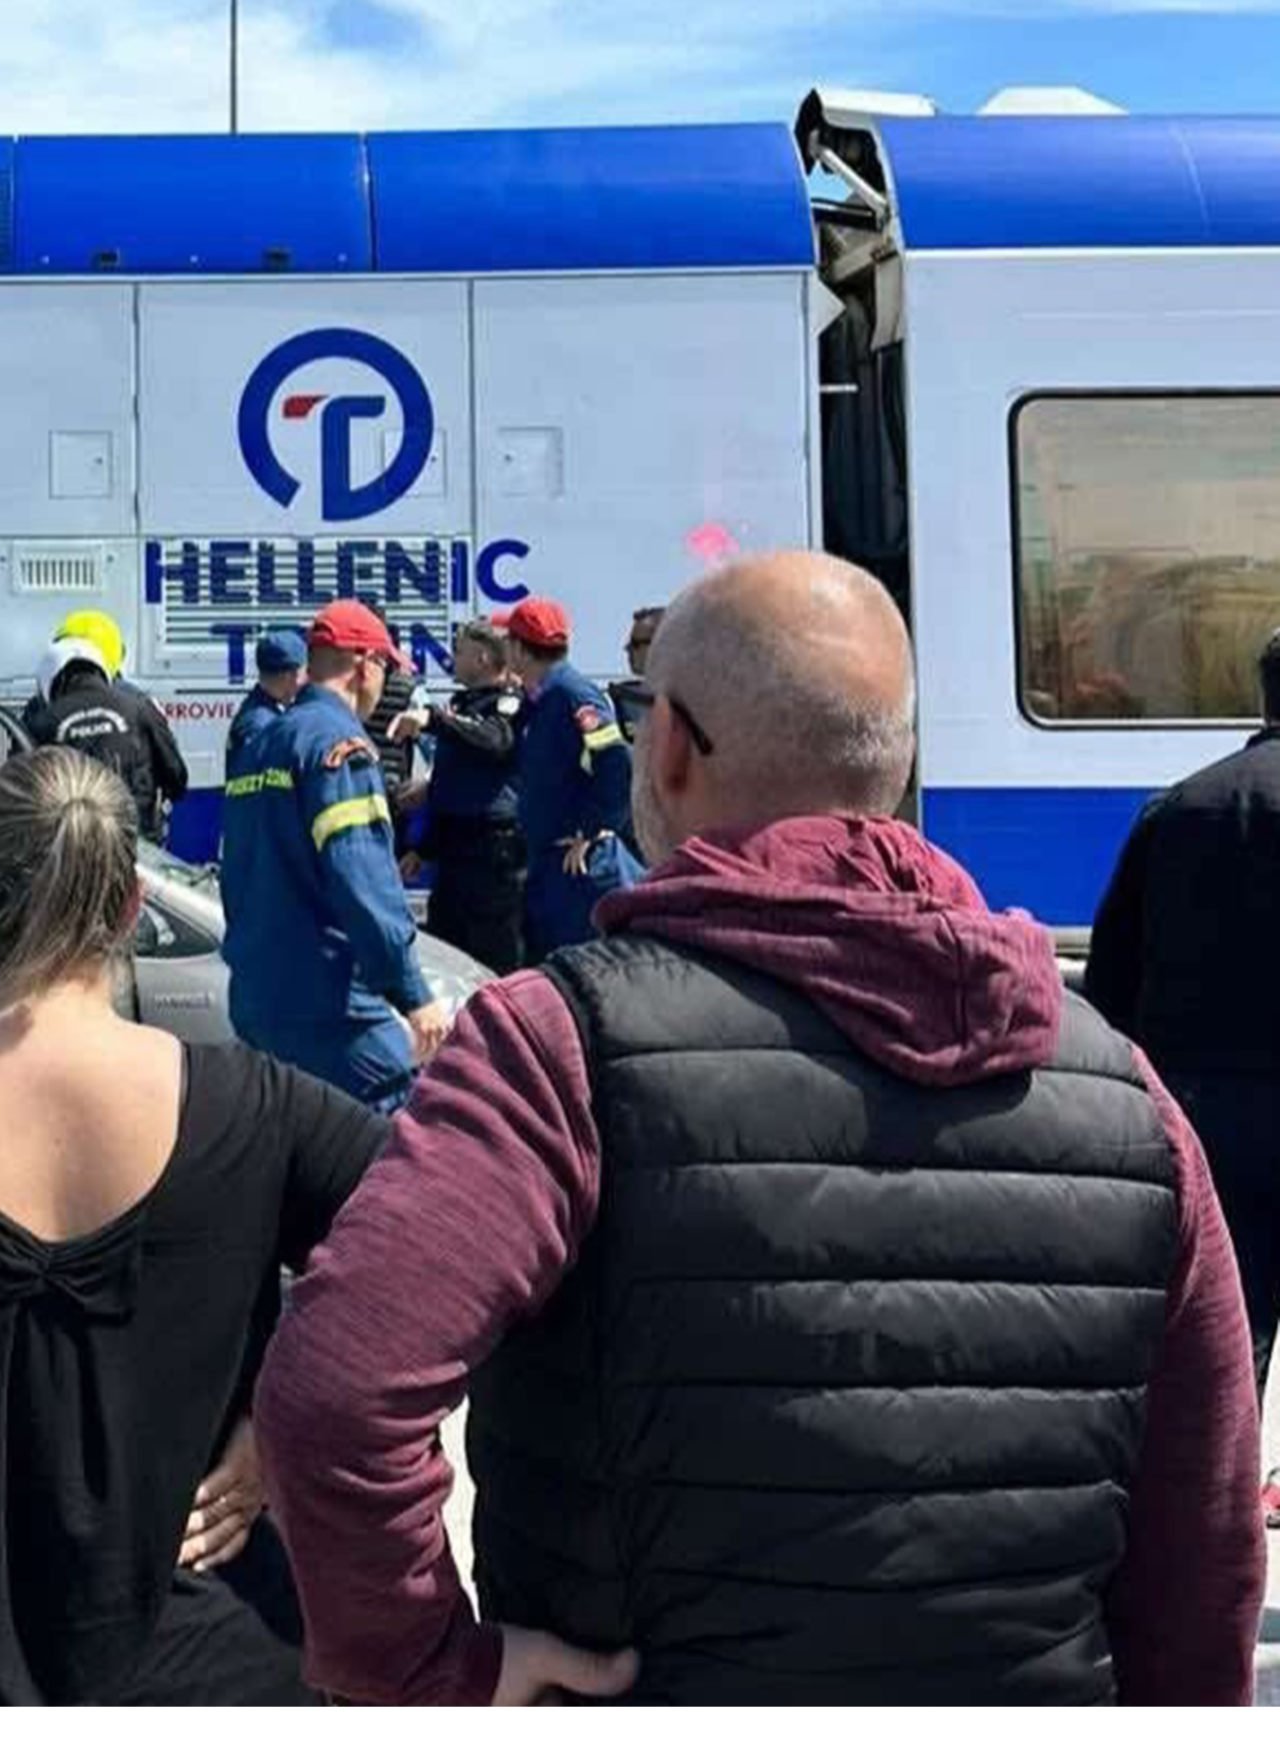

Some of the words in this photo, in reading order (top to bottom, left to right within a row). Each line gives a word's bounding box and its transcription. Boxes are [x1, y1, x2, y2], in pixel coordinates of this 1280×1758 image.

[145, 538, 531, 604] HELLENIC
[161, 702, 234, 718] RROVIE
[70, 721, 112, 739] POLICE
